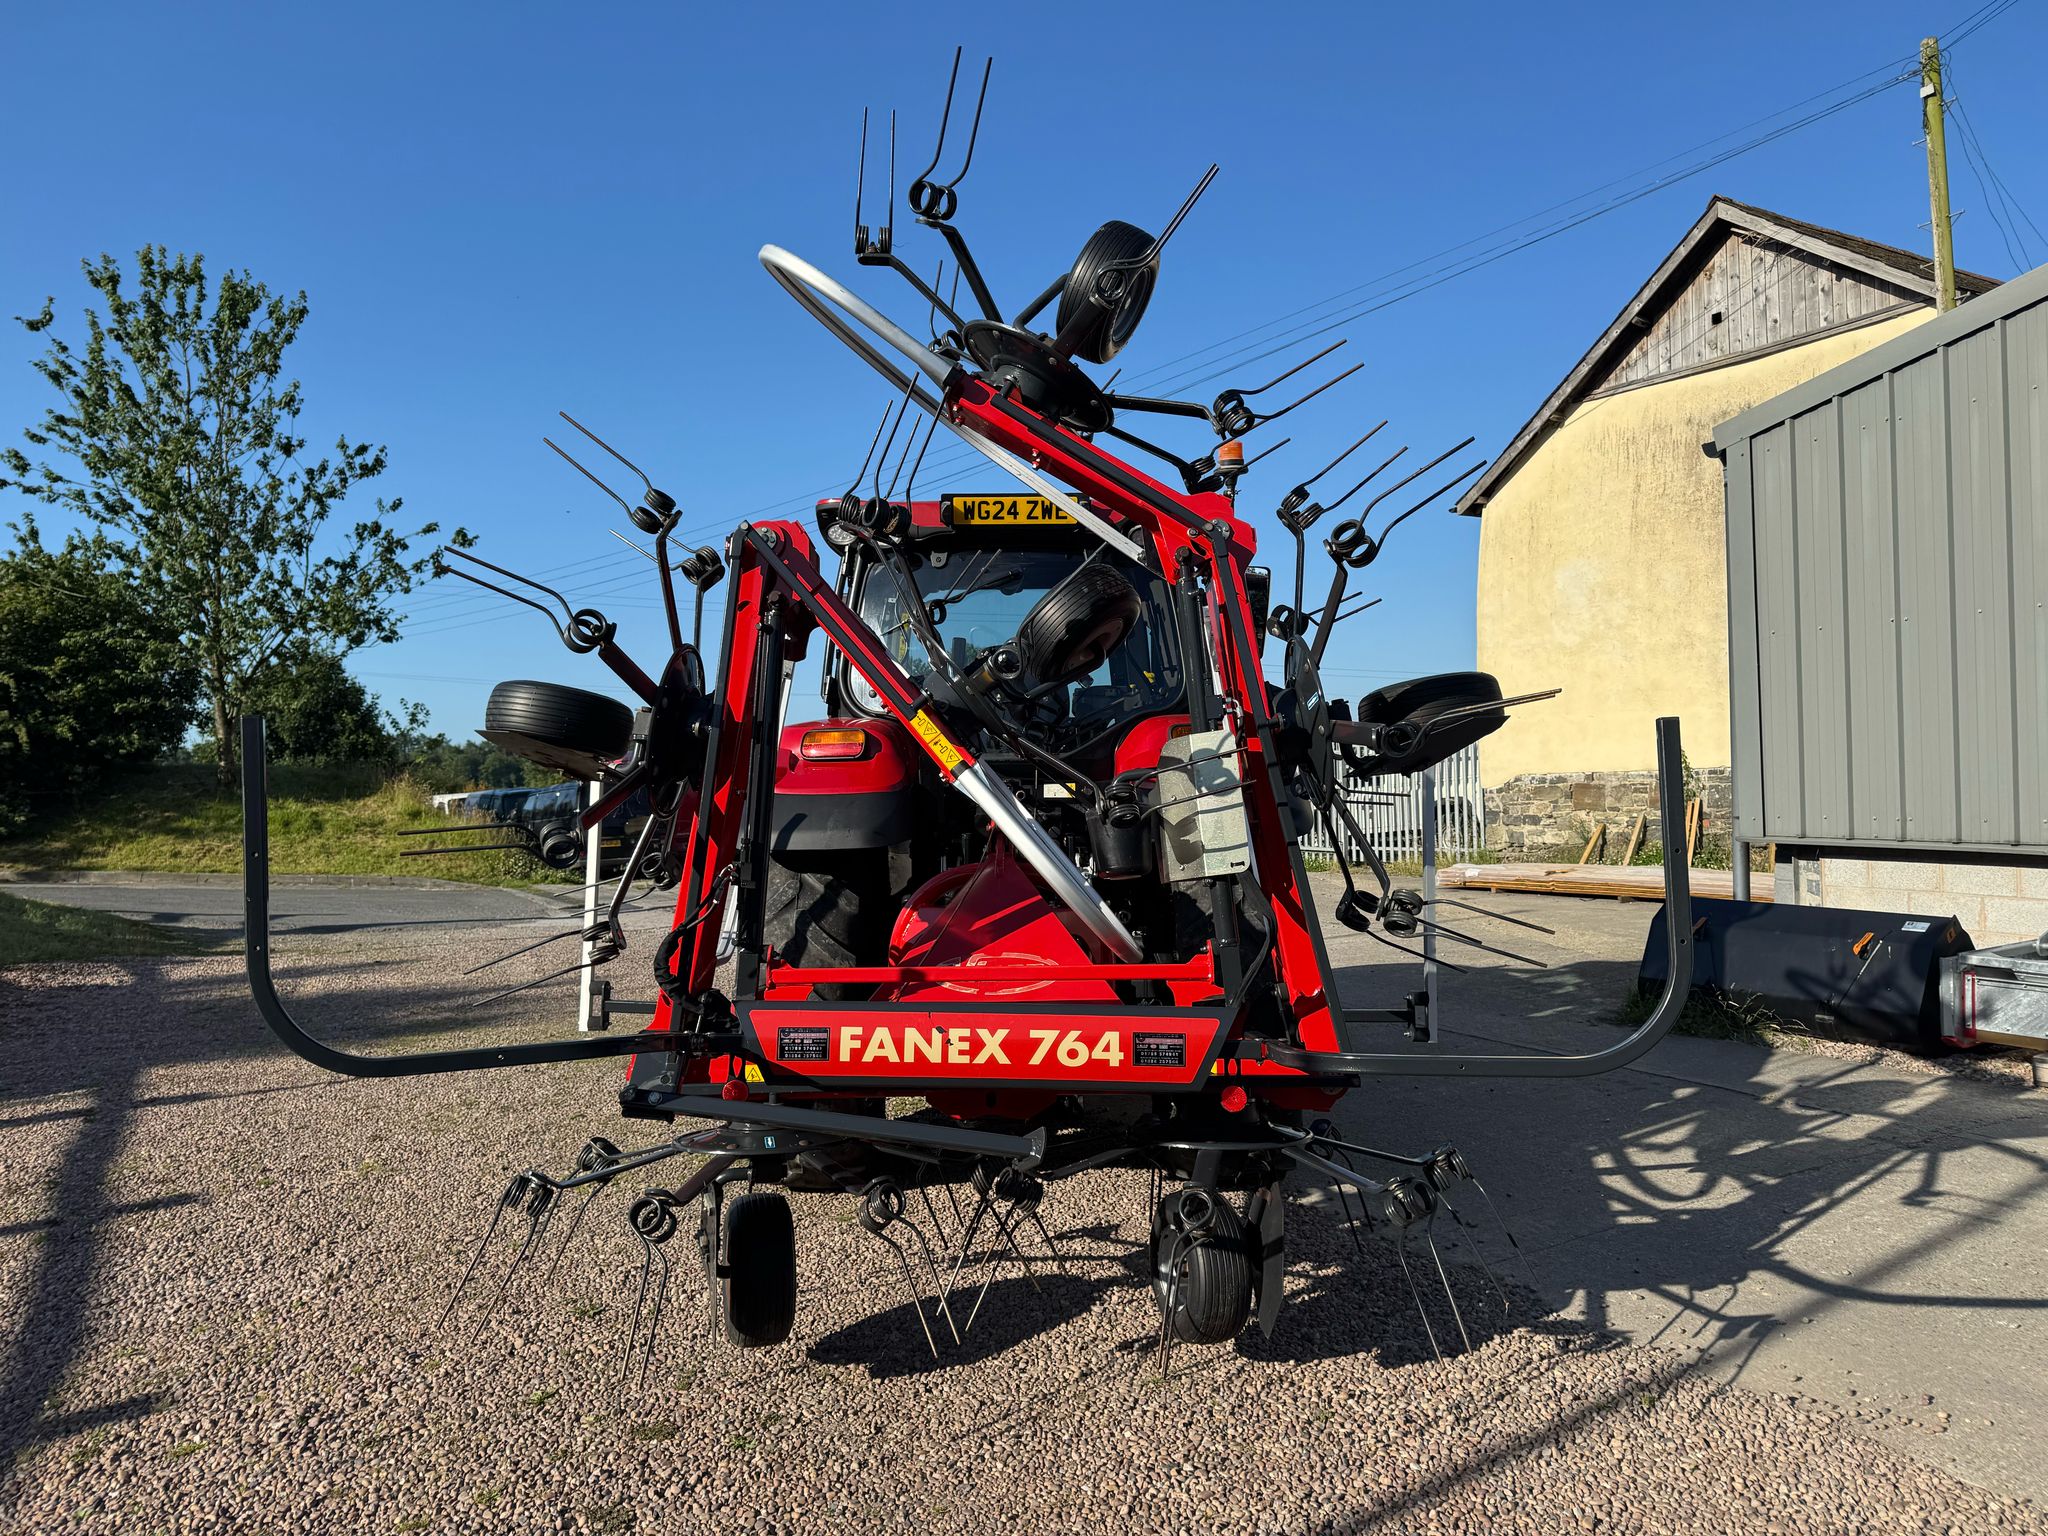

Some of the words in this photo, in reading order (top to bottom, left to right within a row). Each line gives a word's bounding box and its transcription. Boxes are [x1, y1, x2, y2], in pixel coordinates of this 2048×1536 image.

[963, 500, 1019, 520] WG24
[839, 1026, 1012, 1065] FANEX
[1028, 1029, 1124, 1067] 764
